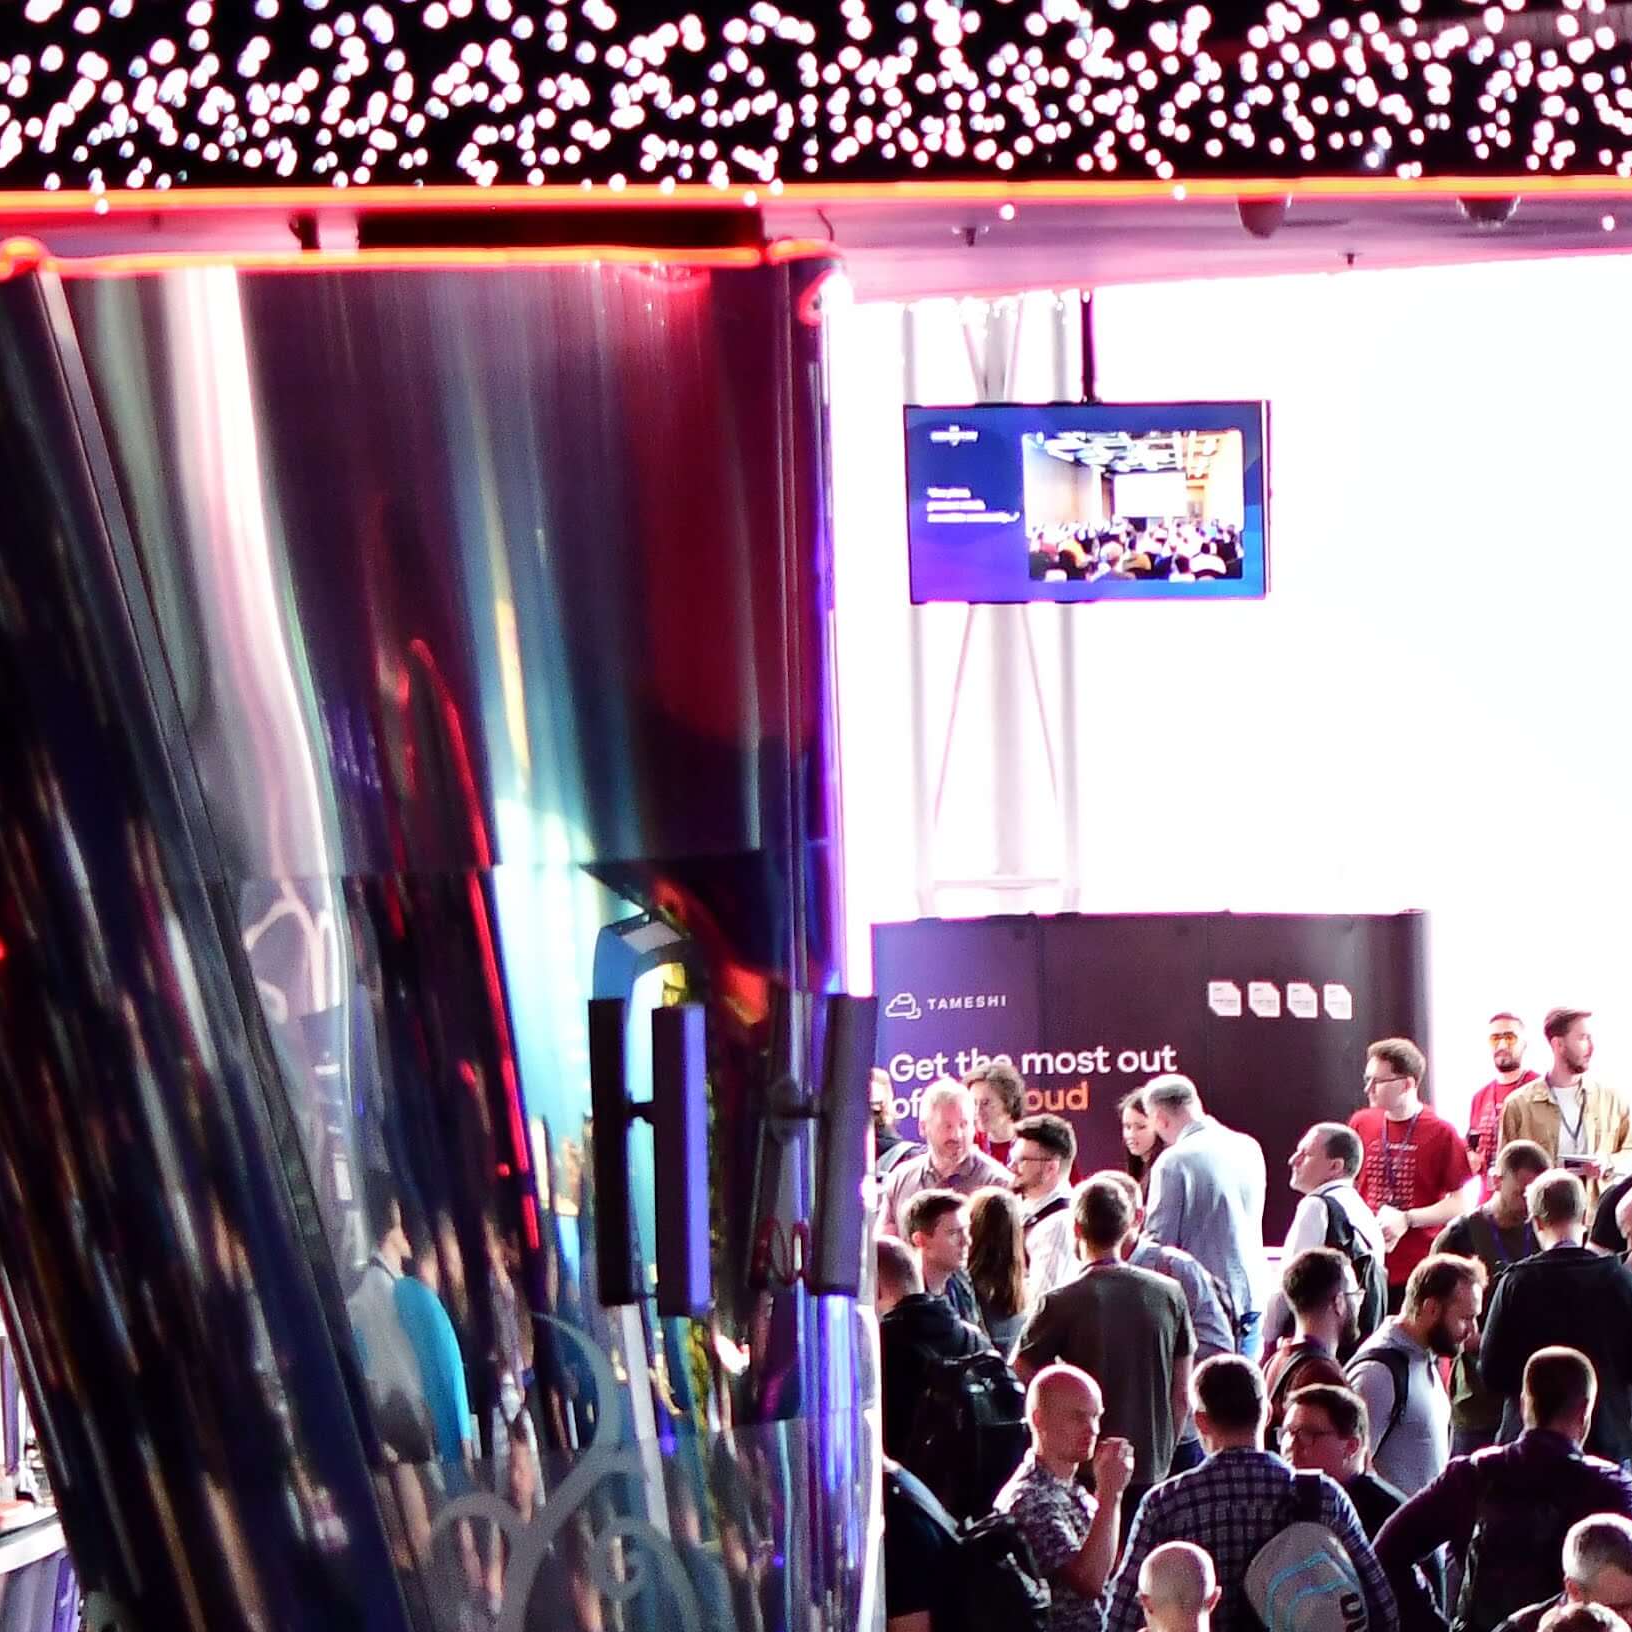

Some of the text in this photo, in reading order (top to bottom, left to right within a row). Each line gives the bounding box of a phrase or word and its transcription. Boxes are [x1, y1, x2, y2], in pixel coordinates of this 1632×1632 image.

[927, 994, 1007, 1011] TAMESHI
[889, 1051, 950, 1082] Get
[1021, 1045, 1111, 1075] most
[1117, 1045, 1178, 1073] out
[1024, 1080, 1089, 1112] oud
